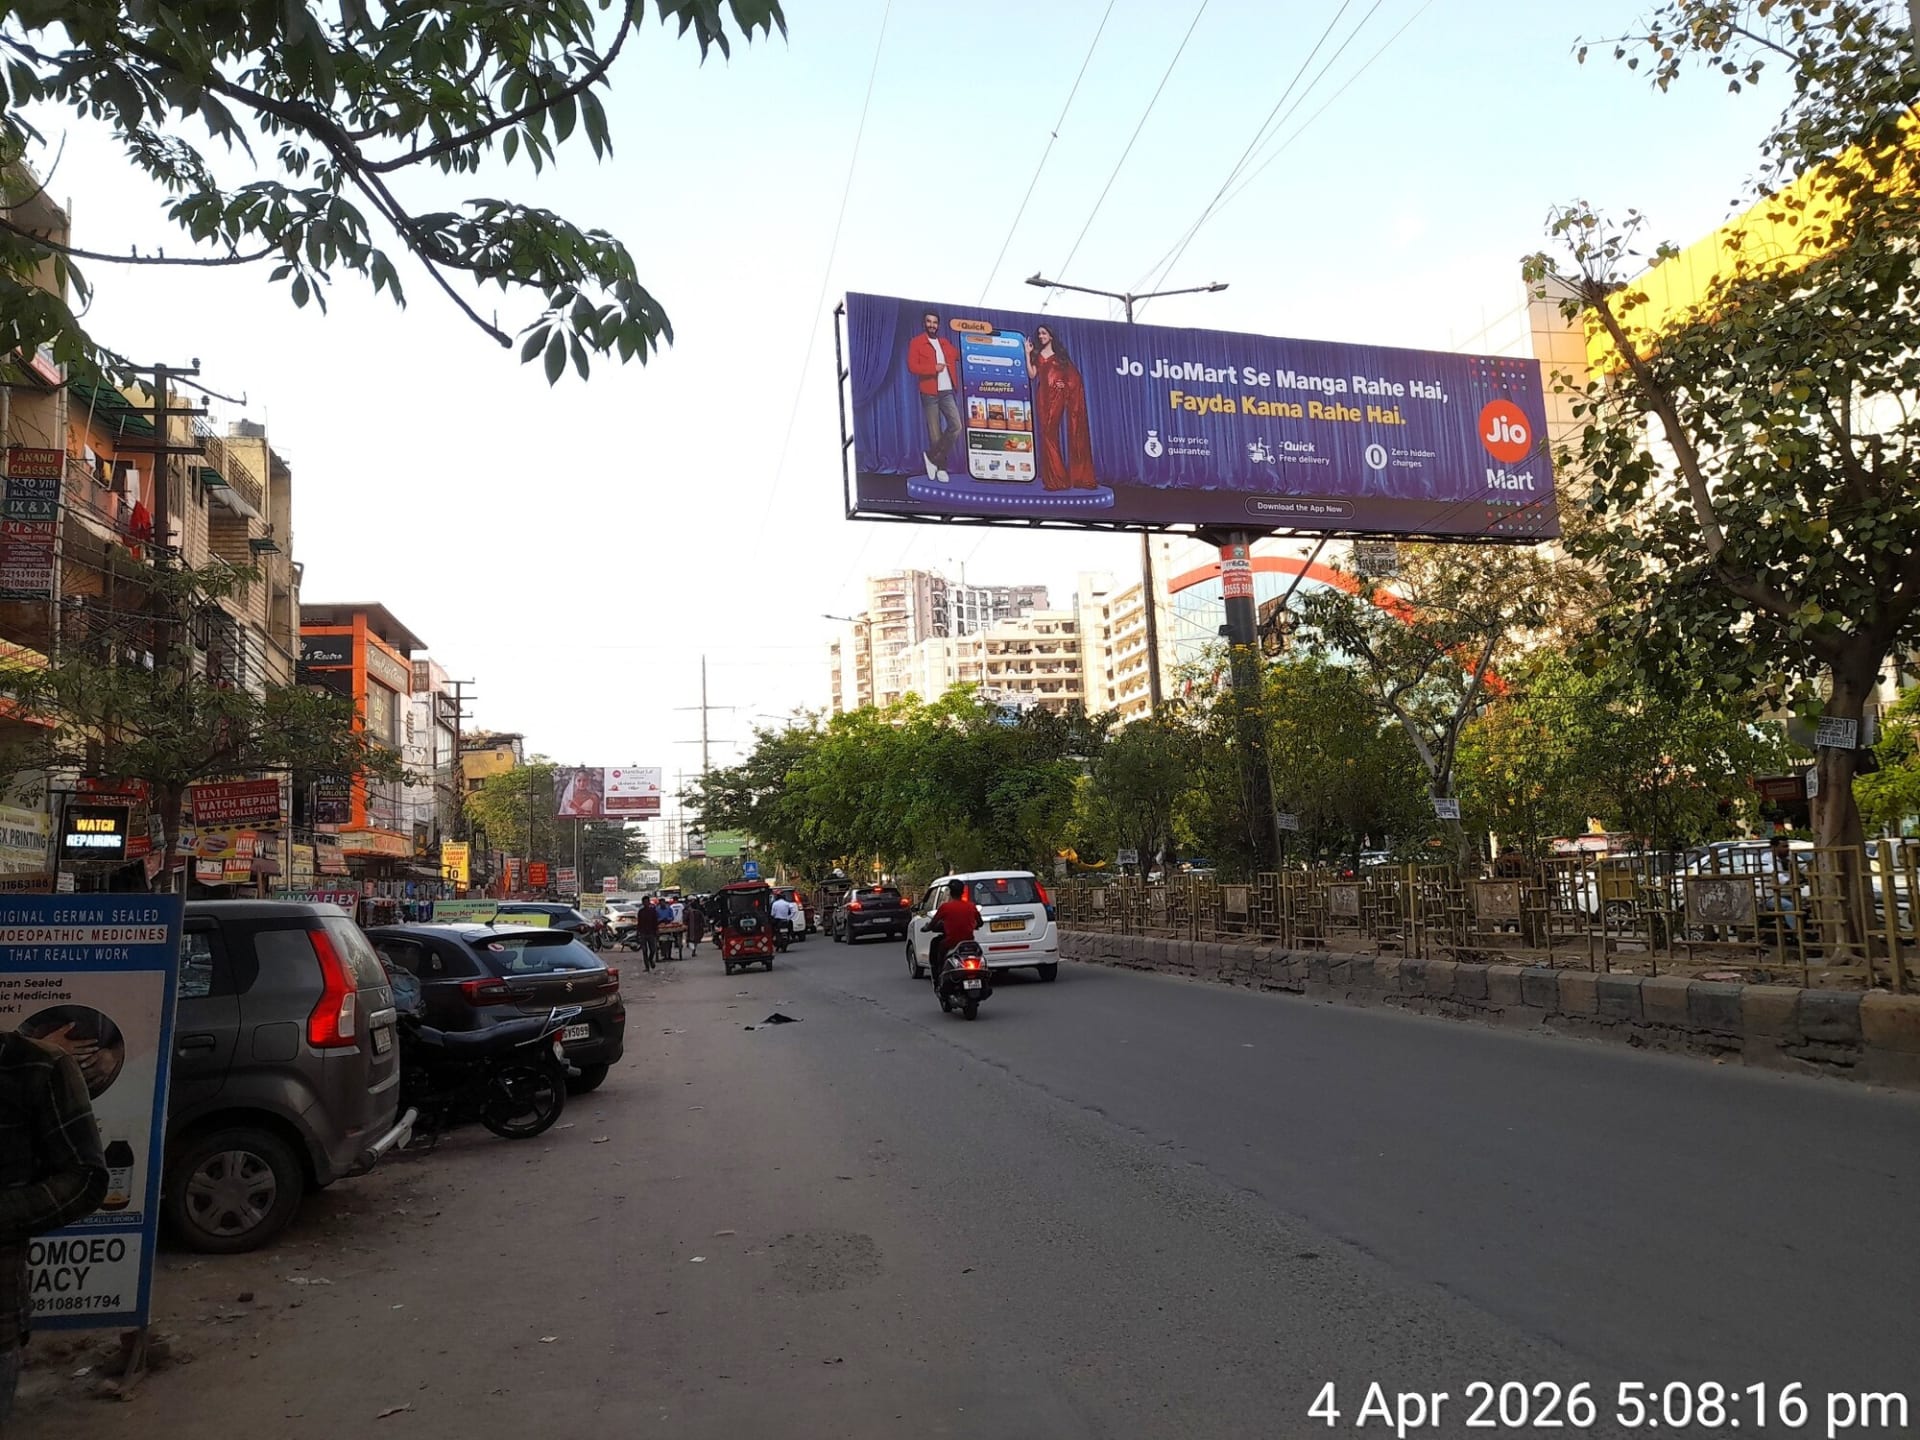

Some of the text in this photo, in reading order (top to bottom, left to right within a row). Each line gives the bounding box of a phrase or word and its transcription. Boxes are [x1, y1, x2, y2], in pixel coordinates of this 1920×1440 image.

[961, 322, 985, 331] Quick
[1116, 356, 1448, 404] Jo JioMart Se Manga Rahe Hai,
[1170, 390, 1406, 425] Fayda Kama Rahe Hai.
[1486, 416, 1527, 444] Jio
[1168, 435, 1209, 447] Low price
[1283, 441, 1315, 453] Quick
[18, 452, 55, 464] ANAND
[1168, 447, 1211, 457] guarantee
[1391, 448, 1436, 458] Zero hidden
[1279, 454, 1330, 466] Free delivery
[1392, 460, 1422, 469] charges
[11, 465, 59, 476] CLASSES
[1486, 468, 1535, 491] Mart
[10, 501, 51, 513] IX & X
[1257, 502, 1343, 515] Download the App Now
[8, 522, 20, 533] XI
[198, 795, 277, 811] WATCH REPAIR
[198, 810, 228, 820] WATCH
[230, 805, 278, 817] COLLECTION
[76, 819, 116, 832] WATCH
[10, 828, 46, 848] PRINTING
[66, 834, 122, 847] REPAIRING
[323, 894, 355, 905] FLEX
[0, 909, 159, 922] IGINAL GERMAN SEALED
[91, 928, 165, 941] MEDICINES
[9, 948, 129, 961] THAT REALLY WORK
[24, 978, 63, 988] Sealed
[14, 991, 72, 1001] Medicines
[29, 1266, 91, 1293] ACY
